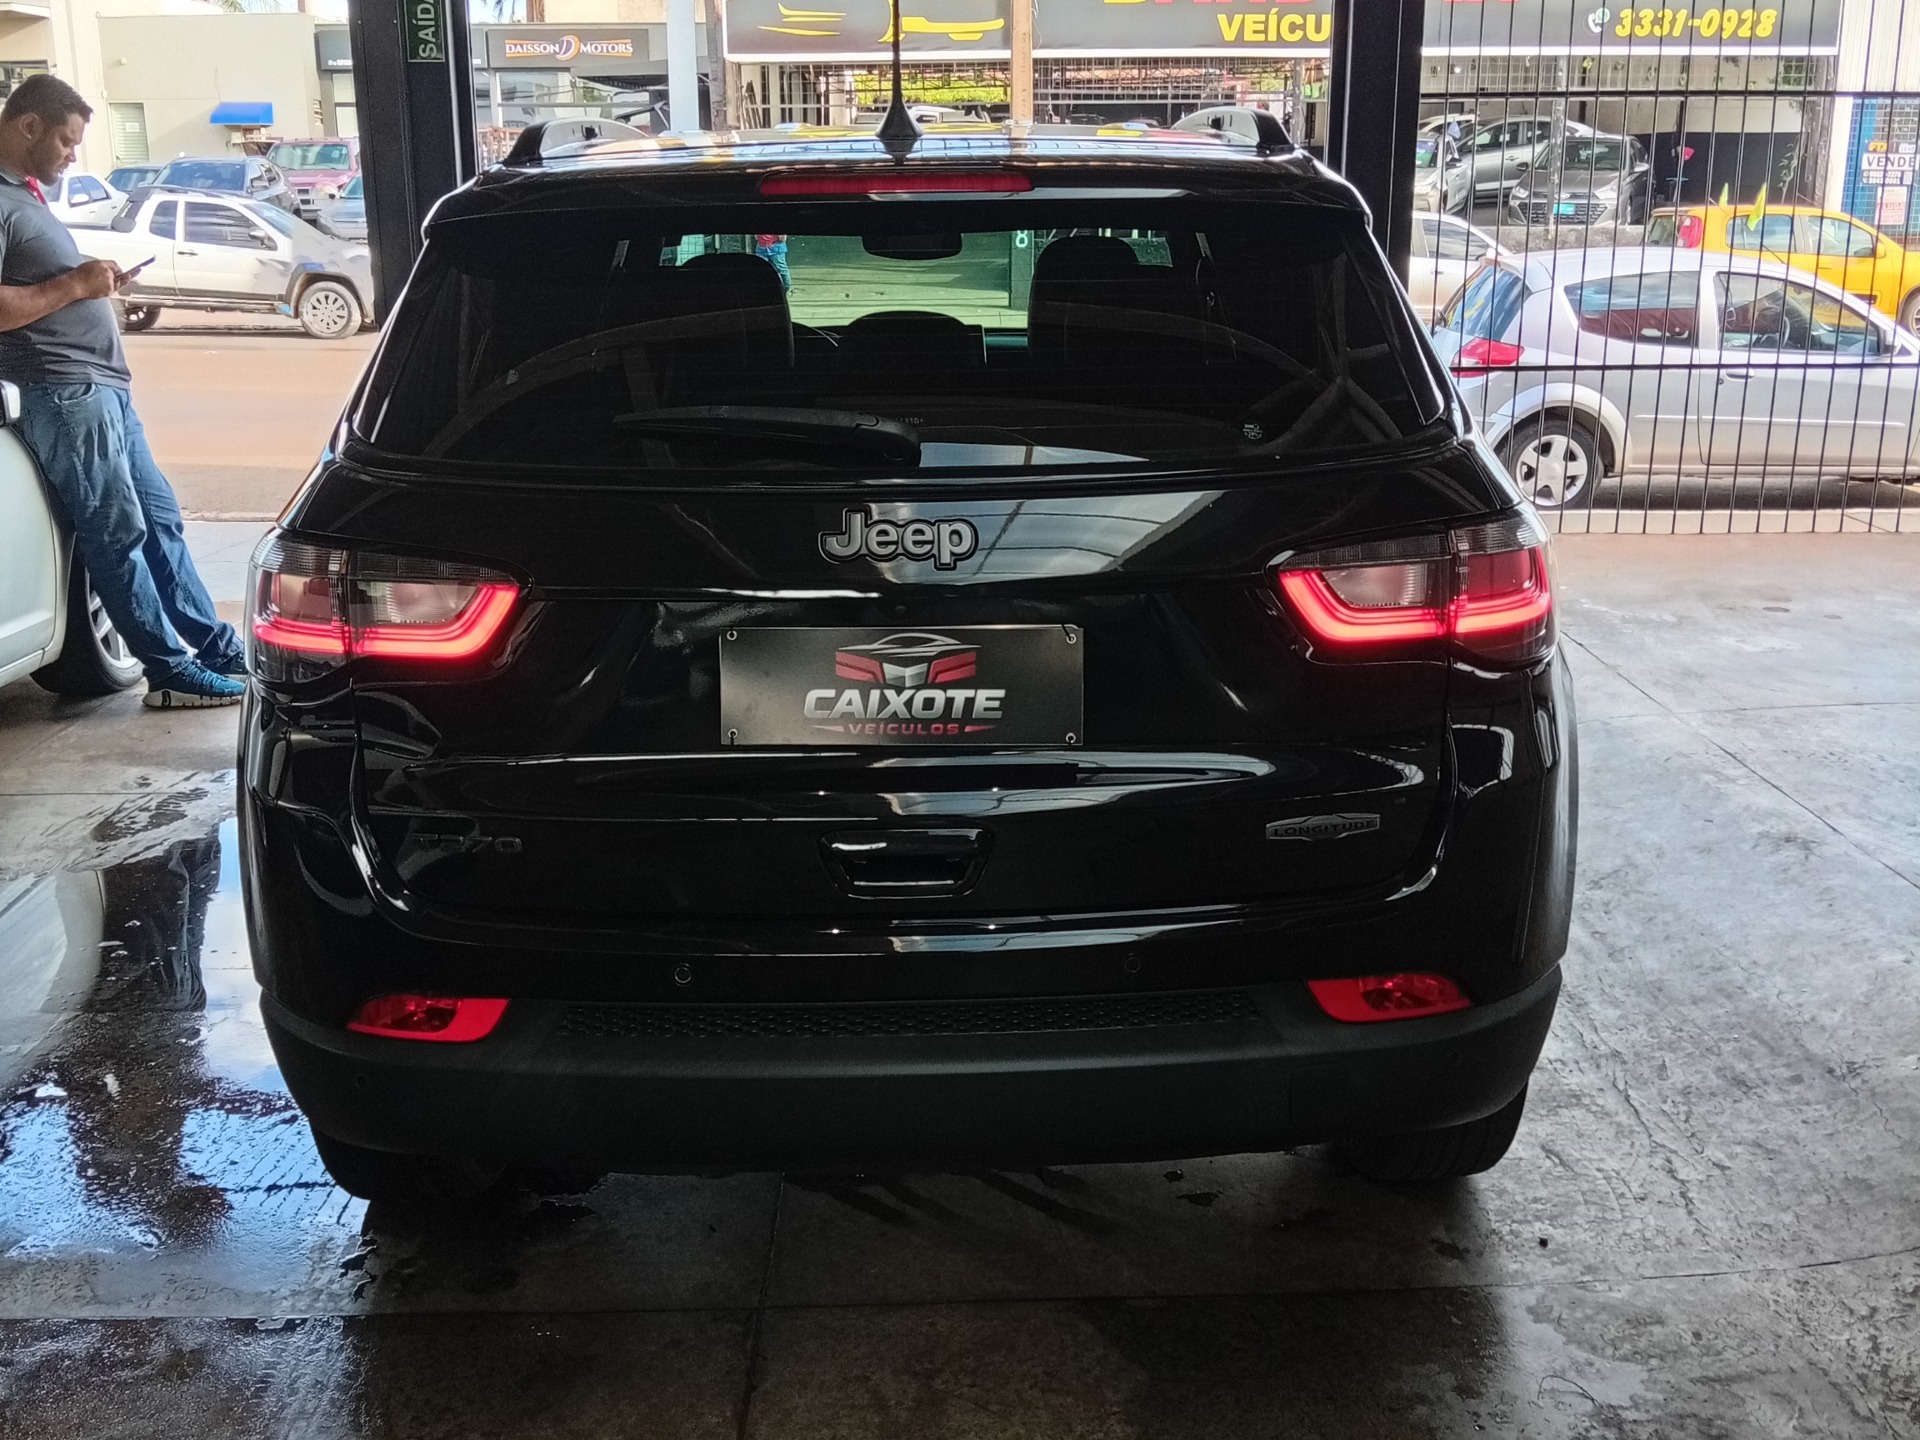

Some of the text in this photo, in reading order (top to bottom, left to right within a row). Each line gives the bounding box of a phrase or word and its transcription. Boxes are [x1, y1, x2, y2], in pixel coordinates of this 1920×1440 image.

[411, 0, 438, 58] SAÍD
[1615, 8, 1778, 39] 3331-0928
[505, 43, 560, 54] DAISSON
[580, 43, 633, 54] MOTORS
[821, 508, 977, 568] Jeep
[803, 688, 1006, 719] CAIXOTE
[848, 721, 960, 735] VEÍCULOS
[1272, 819, 1375, 836] LONGITUDE
